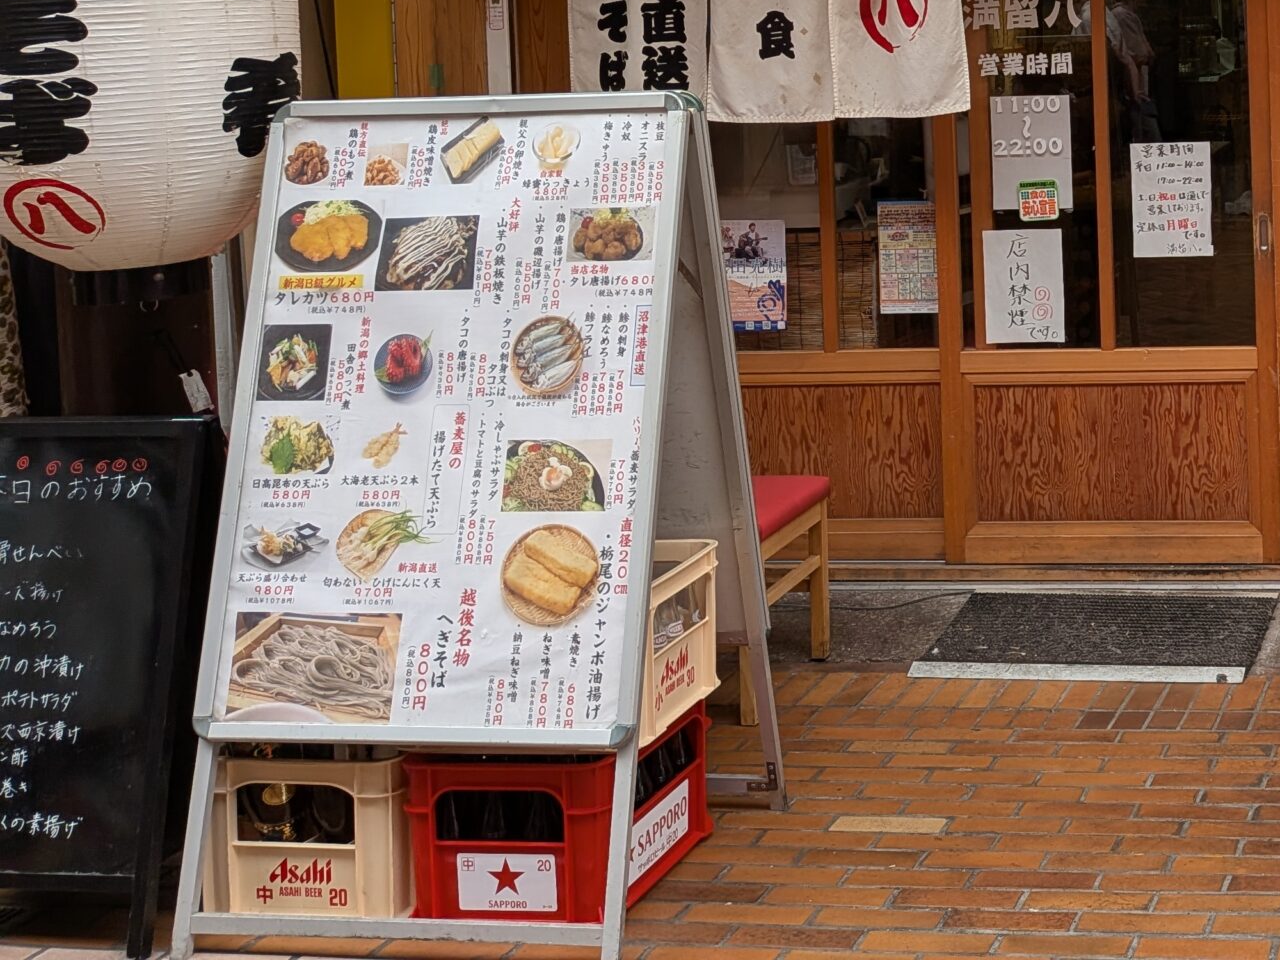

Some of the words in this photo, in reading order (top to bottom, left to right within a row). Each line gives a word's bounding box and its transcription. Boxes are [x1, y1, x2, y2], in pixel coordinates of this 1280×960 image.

[978, 52, 1074, 76] 営業時間
[994, 96, 1060, 113] 11:00
[512, 119, 528, 181] 親父の卵焼き
[601, 121, 614, 162] 梅きゅう
[621, 121, 632, 141] 冷奴
[638, 121, 650, 161] オニスラ
[655, 121, 665, 141] 枝豆
[994, 138, 1063, 156] 22:00
[1141, 144, 1193, 158] 営業時間
[337, 147, 347, 187] 600円
[414, 148, 425, 187] 600円
[422, 125, 438, 187] 鶏皮味噌焼き
[502, 146, 514, 185] 600円
[1135, 160, 1151, 172] 平日
[522, 179, 590, 189] 蜂蜜らっきょう
[600, 163, 610, 203] 350円
[618, 162, 628, 203] 350円
[634, 161, 646, 202] 350円
[653, 161, 664, 201] 350円
[509, 198, 521, 231] 大好評
[492, 217, 508, 304] 山芋の鉄板焼き
[531, 213, 546, 290] 山芋の磯辺揚げ
[553, 213, 566, 267] 鶏の唐揚げ
[283, 277, 356, 288] 新潟B級グルメ
[482, 249, 492, 293] 750円
[521, 262, 532, 304] 550円
[550, 268, 561, 310] 700円
[571, 265, 609, 274] 当店名物
[1007, 234, 1033, 328] 店内禁煙
[355, 317, 372, 394] 新潟の郷土料理
[457, 317, 470, 383] タコの唐揚げ
[497, 317, 512, 396] タコの刺身又は
[633, 311, 650, 375] 沼津港直送
[333, 360, 345, 403] 580円
[476, 354, 487, 397] 850円
[578, 372, 589, 415] 800円
[595, 372, 605, 415] 780円
[613, 370, 624, 413] 780円
[448, 412, 466, 469] 蕎麦屋の
[488, 420, 505, 501] 冷しゃぶサラダ
[272, 490, 311, 500] 580円
[363, 490, 400, 500] 580円
[613, 459, 625, 504] 700円
[464, 520, 476, 564] 800円
[483, 520, 496, 564] 750円
[613, 517, 633, 595] 直径20cm
[398, 562, 438, 574] 新潟直送
[254, 585, 294, 596] 980円
[354, 587, 392, 597] 970円
[453, 588, 477, 667] 越後名物
[585, 547, 614, 720] 栃尾のジャンボ油揚げ
[430, 614, 454, 689] へぎそば
[507, 632, 522, 703] 納豆ねぎ味噌
[540, 632, 552, 680] ねぎ味噌
[660, 643, 689, 687] Asahi
[412, 644, 431, 711] 800円
[687, 666, 695, 687] 30
[1, 691, 78, 711] ポテトサラダ
[493, 679, 505, 726] 850円
[536, 682, 548, 728] 780円
[564, 683, 576, 728] 680円
[638, 796, 687, 857] SAPPORO
[269, 857, 332, 885] Asahi
[537, 860, 551, 871] 20
[257, 885, 273, 904] 中
[279, 887, 301, 897] ASAHI
[305, 887, 322, 898] BEER
[329, 889, 348, 906] 20
[488, 900, 527, 909] SAPPORO
